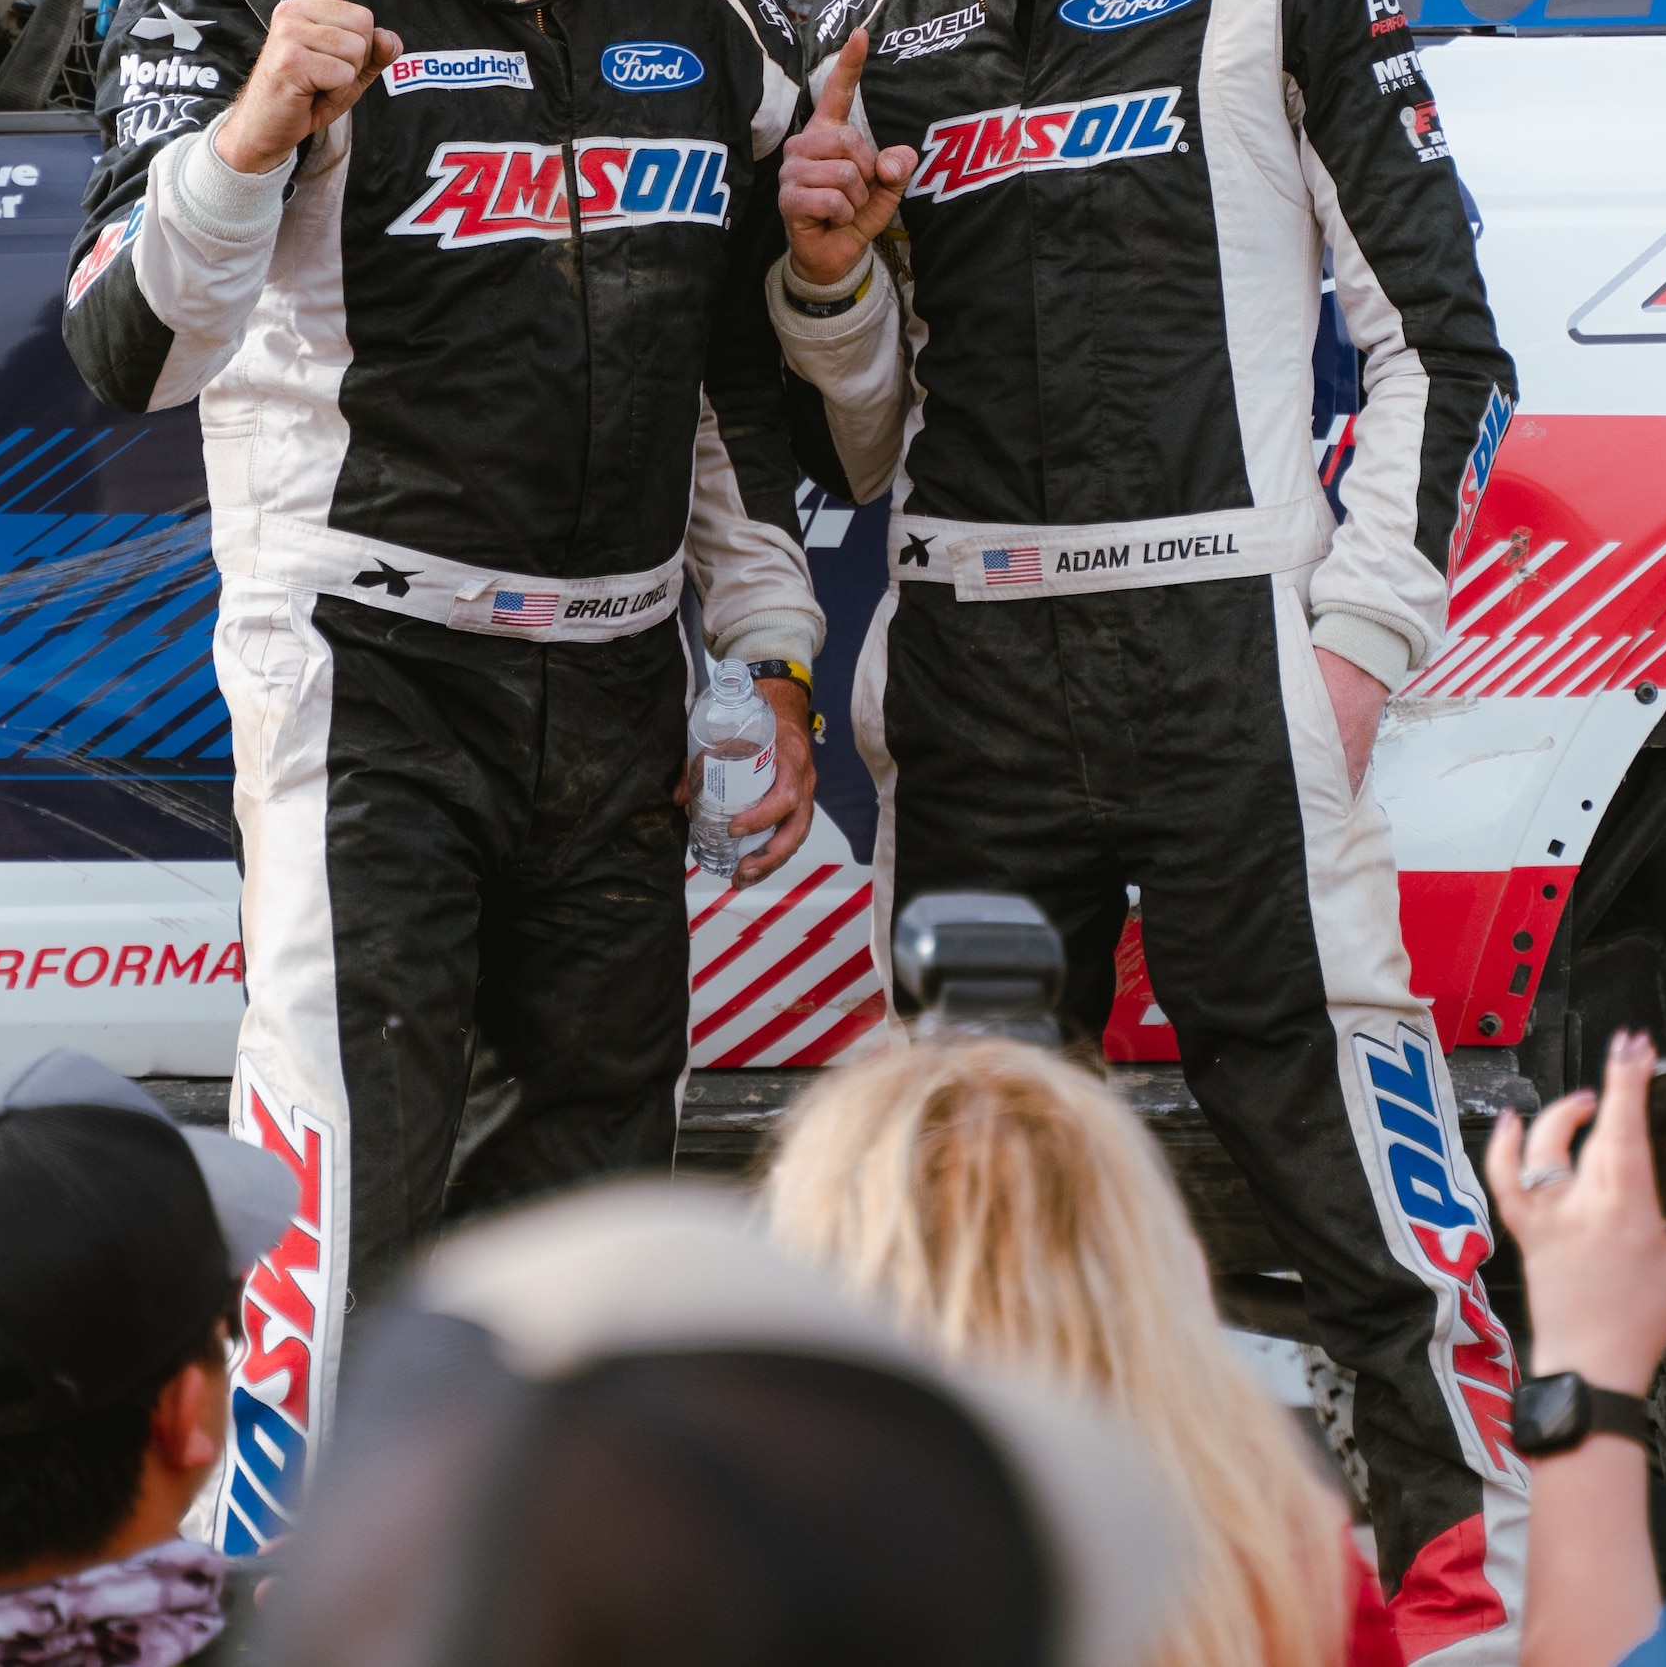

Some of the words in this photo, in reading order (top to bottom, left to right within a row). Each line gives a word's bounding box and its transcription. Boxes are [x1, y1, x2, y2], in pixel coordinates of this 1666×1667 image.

[878, 3, 986, 55] LOVELL
[613, 49, 685, 82] Ford
[893, 34, 967, 65] Racing
[1373, 50, 1421, 84] MET
[120, 54, 220, 88] Motive
[393, 56, 519, 82] BFGoodrich
[1380, 75, 1416, 95] RACE
[116, 96, 204, 148] FOX
[911, 88, 1184, 199] AMSOIL
[401, 139, 729, 246] AMSOIL
[1055, 545, 1130, 574] ADAM
[1142, 533, 1239, 564] LOVELL
[564, 597, 628, 619] BRAD
[630, 580, 668, 614] LOVELL
